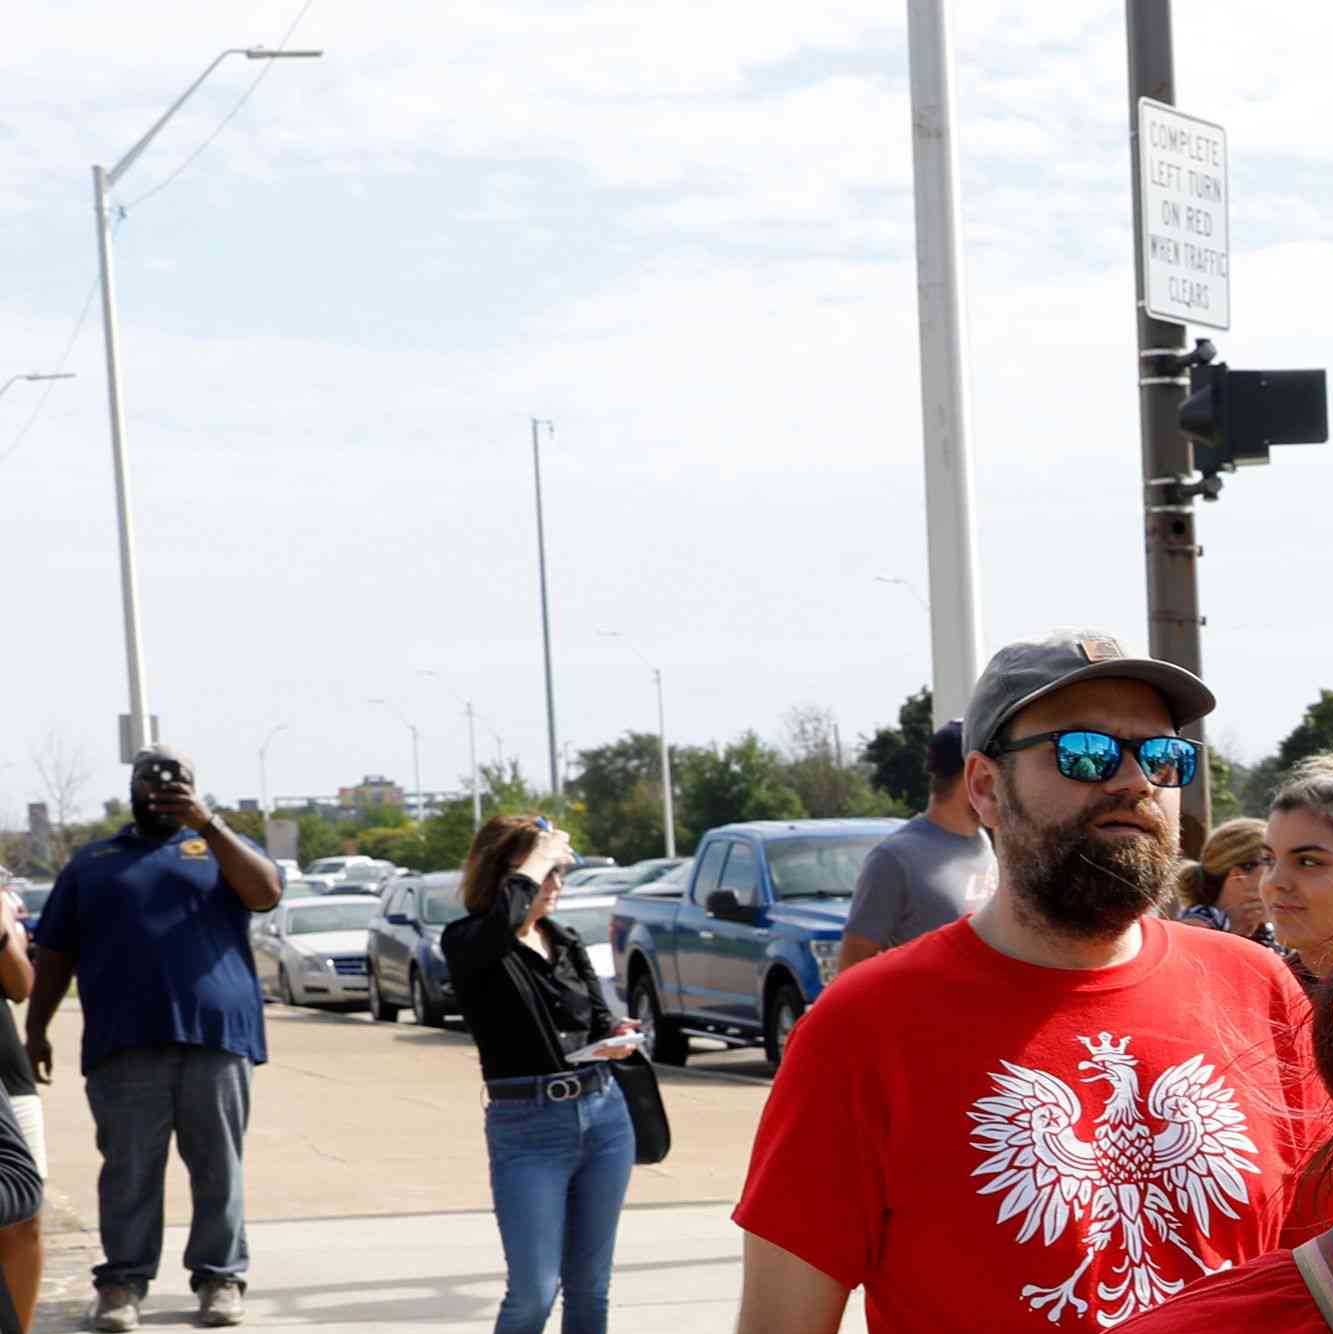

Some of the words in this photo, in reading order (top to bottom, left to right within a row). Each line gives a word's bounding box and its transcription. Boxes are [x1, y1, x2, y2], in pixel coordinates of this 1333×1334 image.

[1150, 120, 1220, 166] COMPLETE
[1151, 160, 1182, 191] LEFT
[1188, 169, 1222, 203] TURN
[1161, 199, 1181, 229] ON
[1185, 206, 1212, 237] RED
[1150, 233, 1181, 265] WHEN
[1184, 242, 1227, 278] TRAFFIC
[1169, 275, 1210, 310] CLEARS
